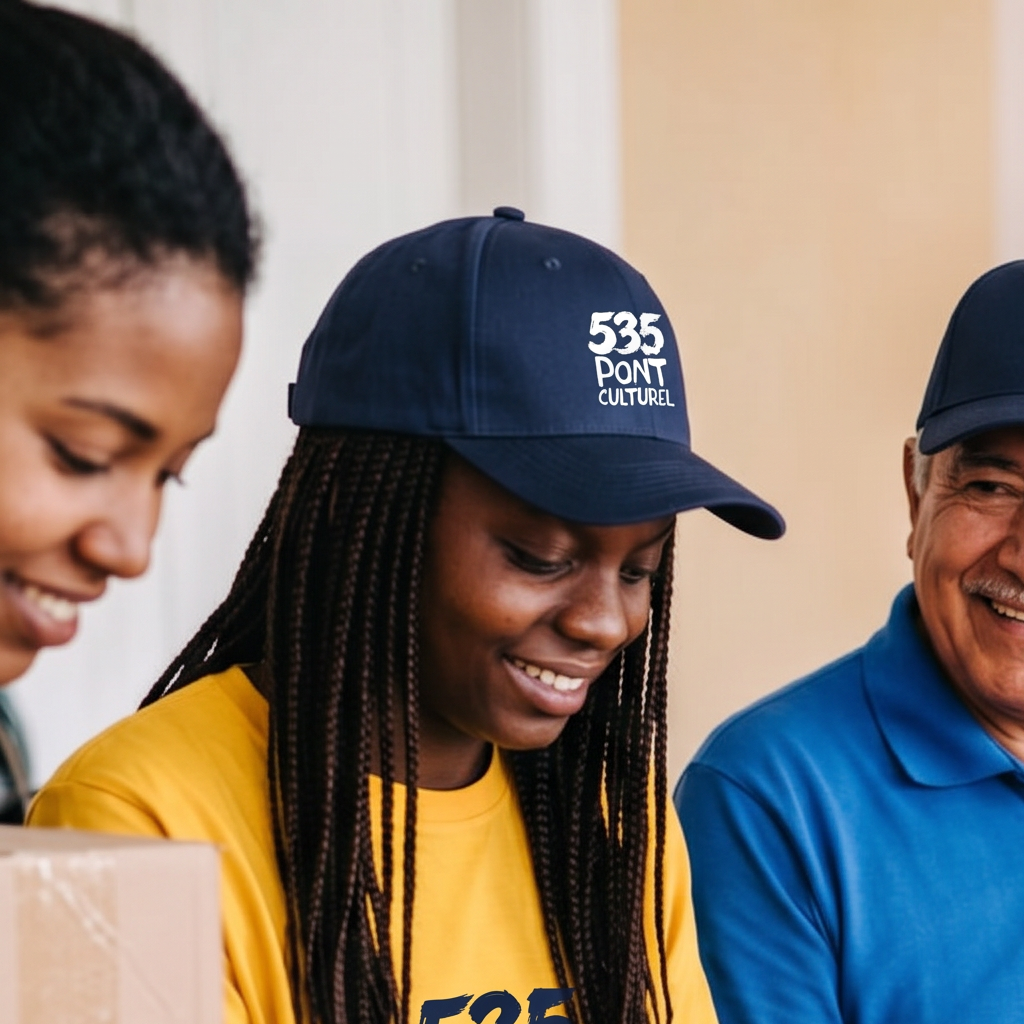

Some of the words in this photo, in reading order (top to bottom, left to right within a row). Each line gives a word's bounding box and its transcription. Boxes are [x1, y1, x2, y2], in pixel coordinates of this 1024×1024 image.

[588, 310, 664, 356] 535
[594, 355, 668, 387] PONT
[597, 386, 675, 407] CULTUREL
